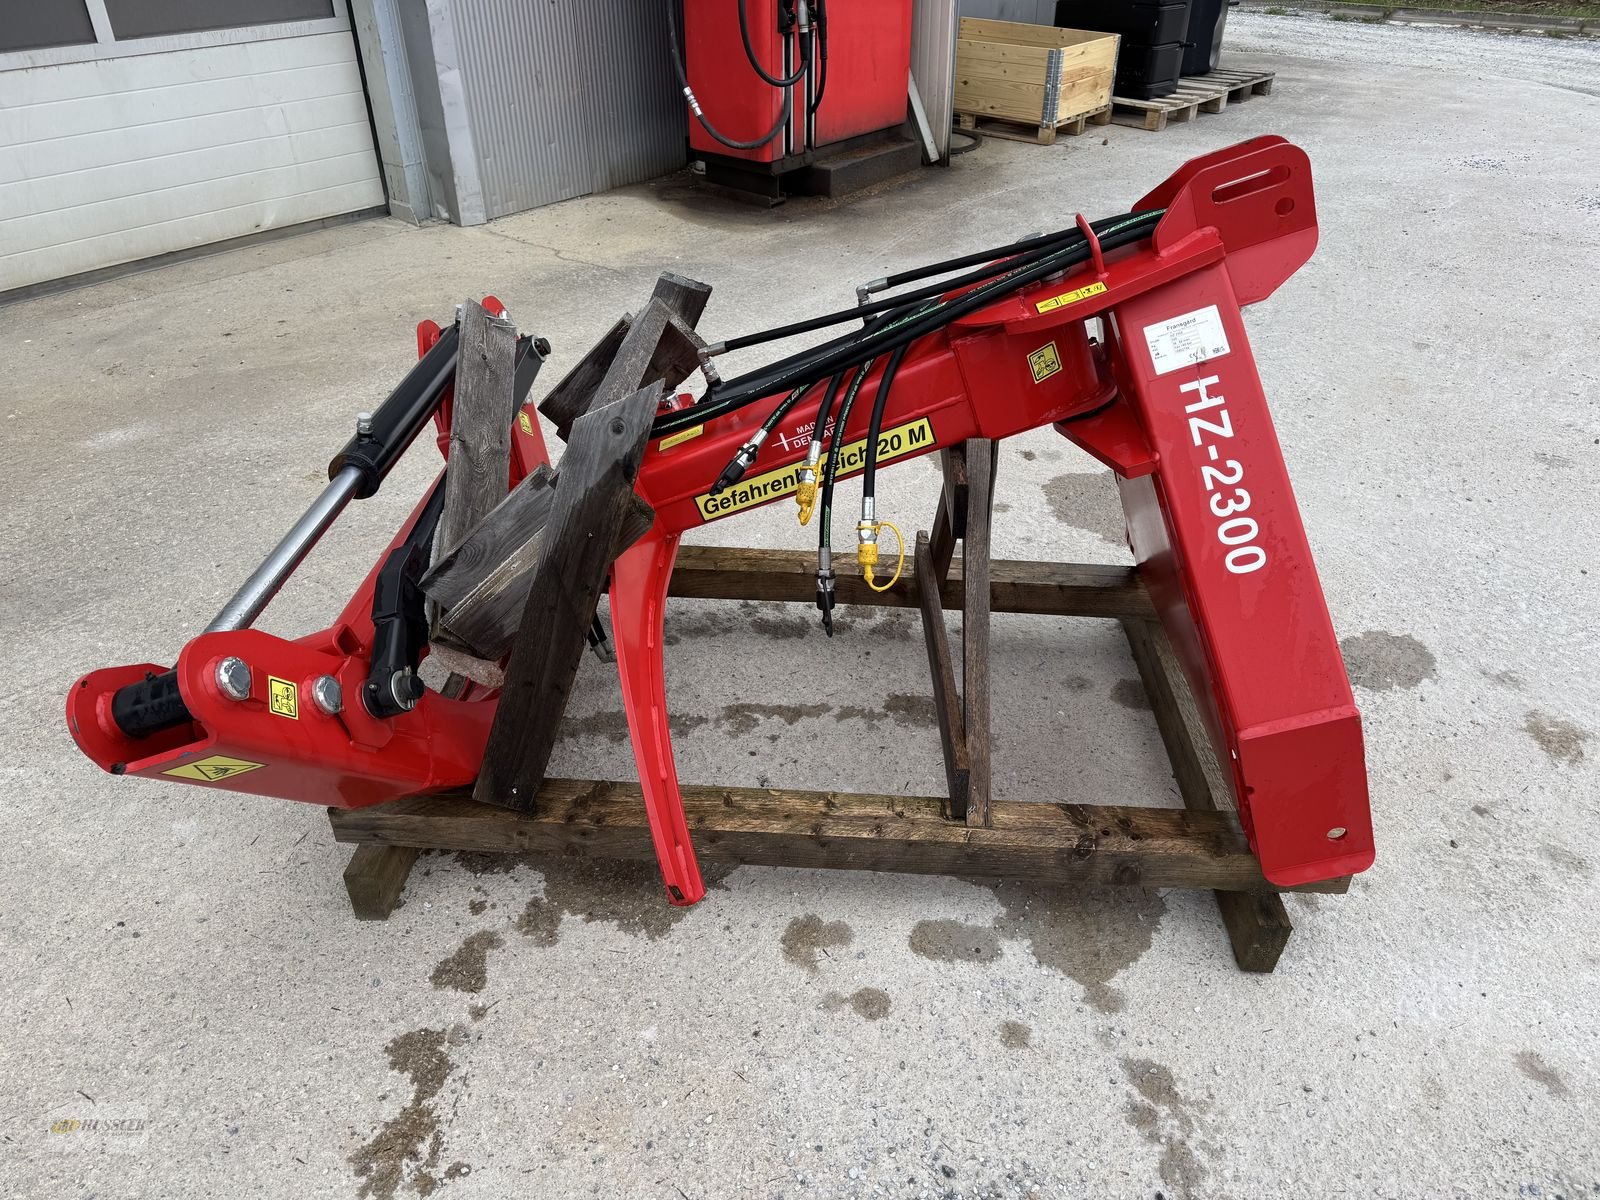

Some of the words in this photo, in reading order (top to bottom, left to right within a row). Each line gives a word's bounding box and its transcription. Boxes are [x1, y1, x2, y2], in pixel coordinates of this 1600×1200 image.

[796, 421, 816, 435] MAD
[877, 433, 902, 456] 20
[908, 424, 926, 446] M
[1179, 375, 1267, 574] HZ-2300
